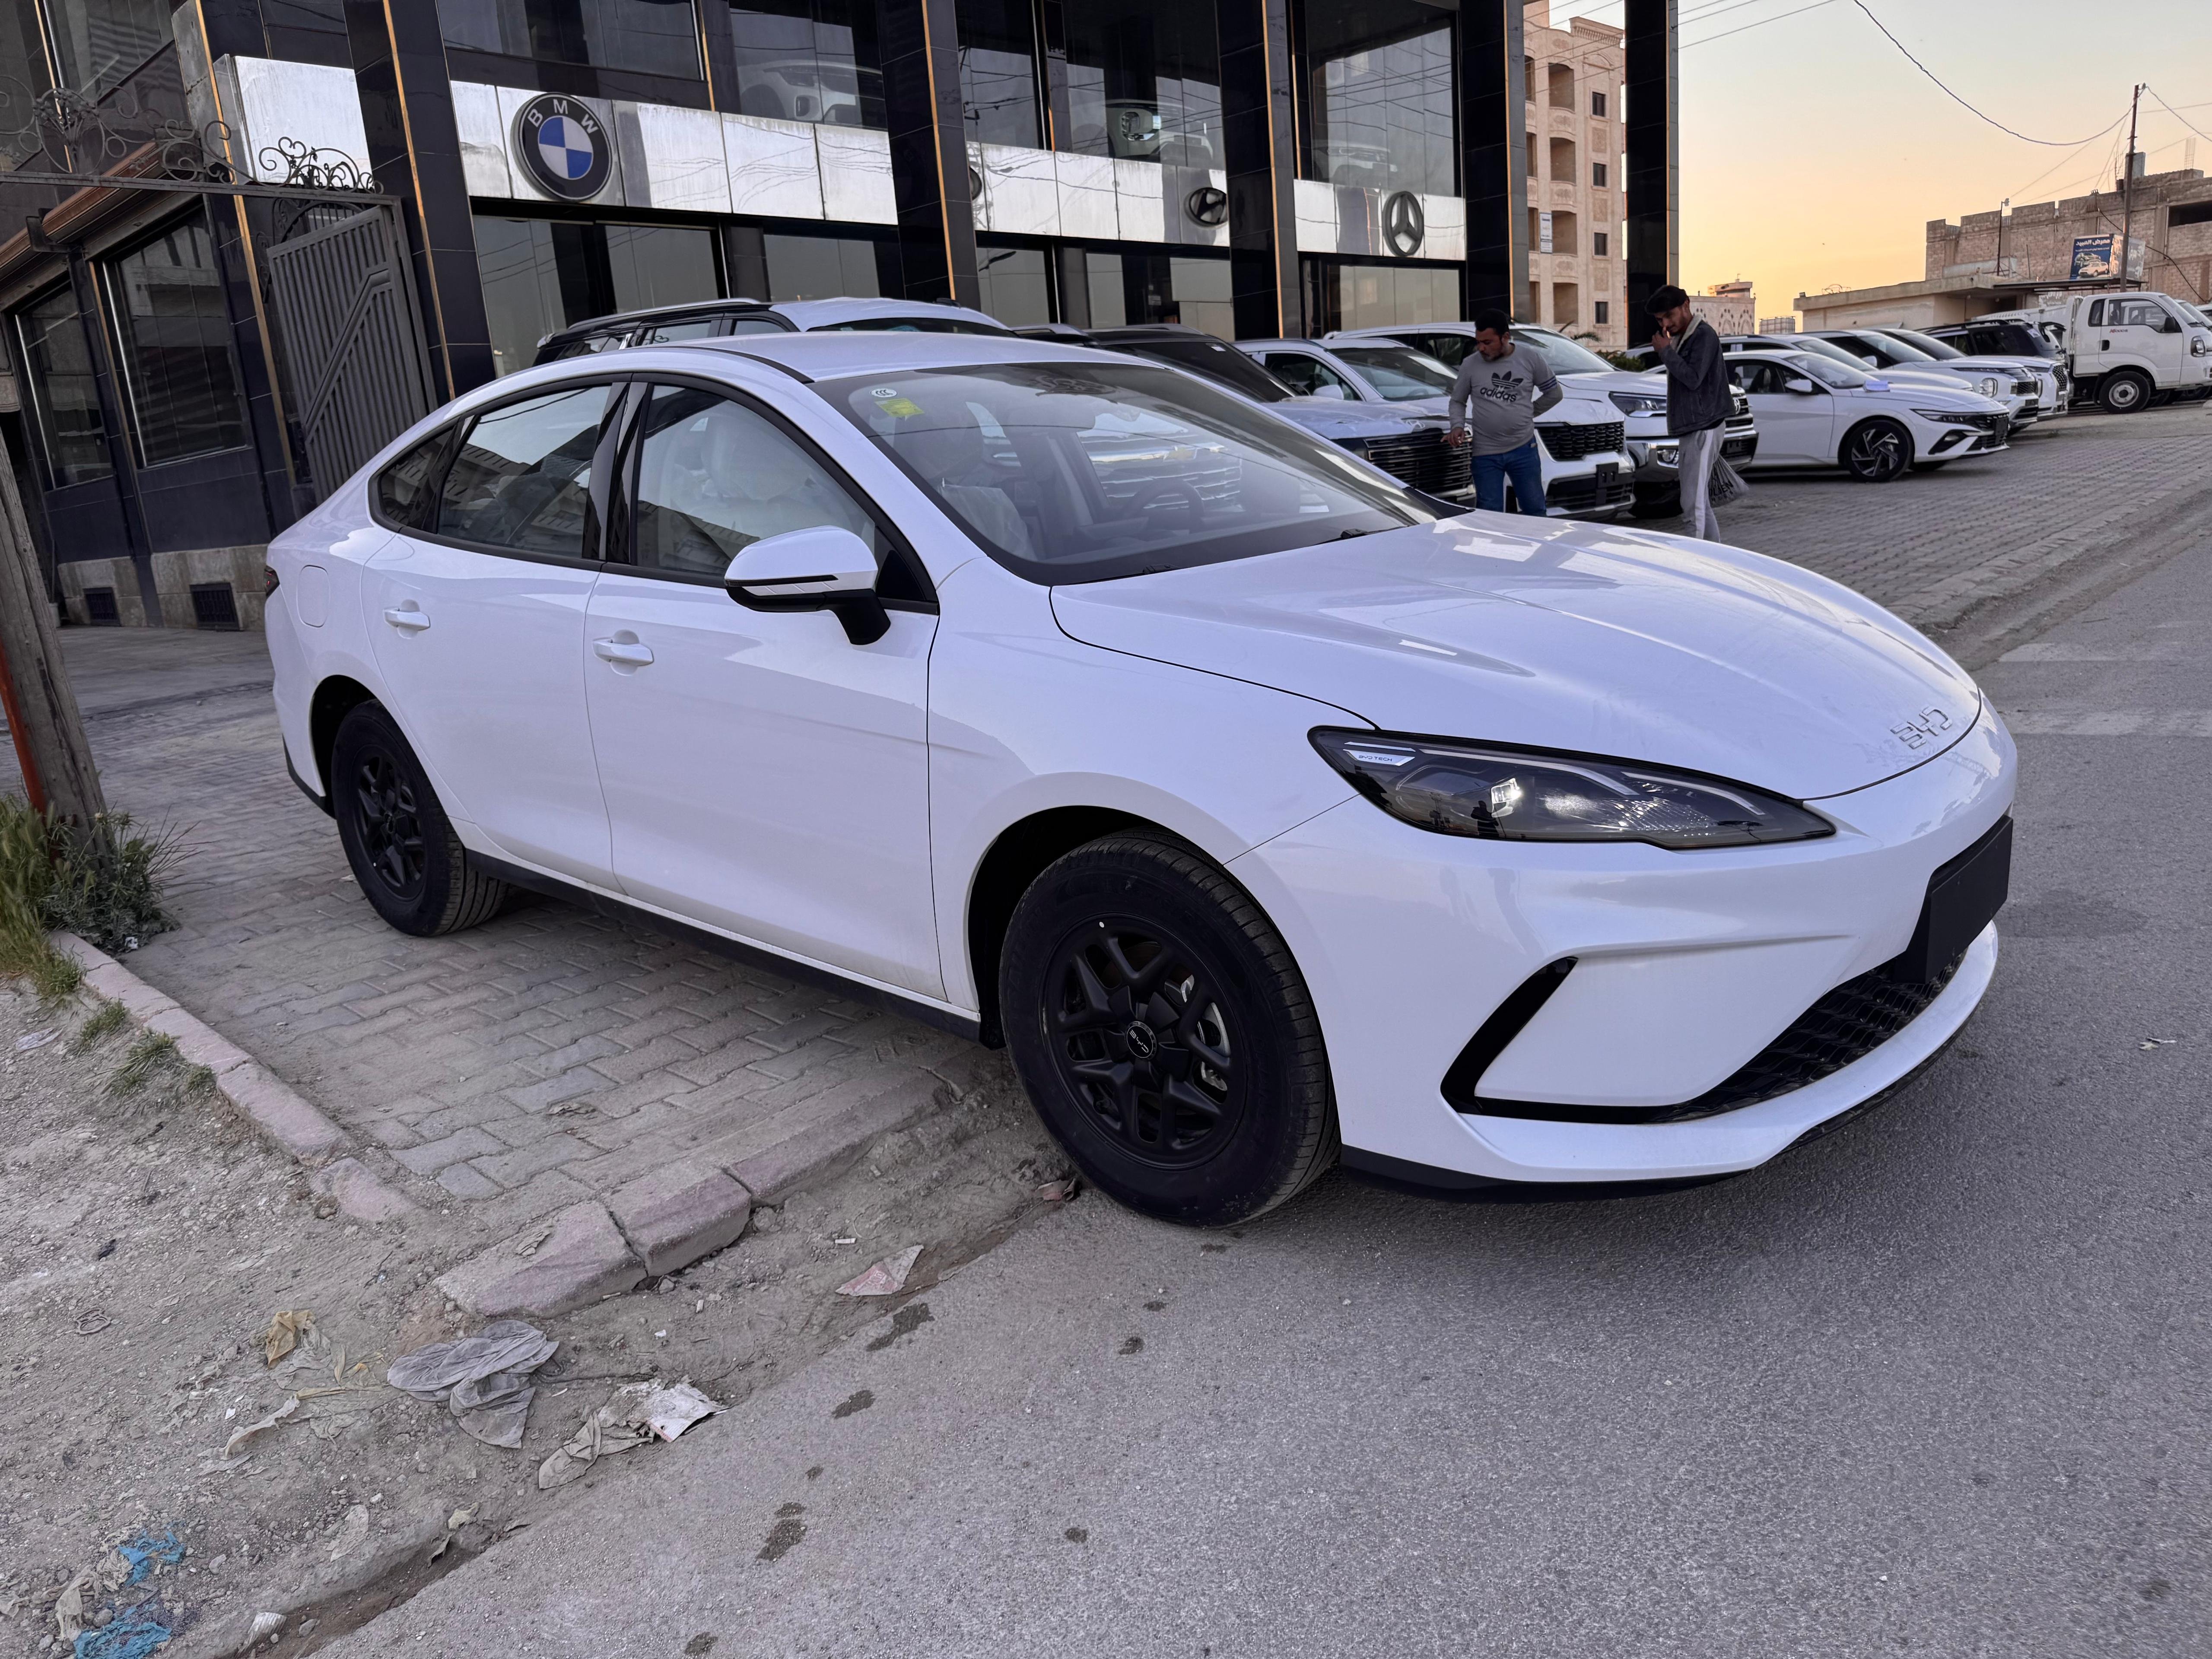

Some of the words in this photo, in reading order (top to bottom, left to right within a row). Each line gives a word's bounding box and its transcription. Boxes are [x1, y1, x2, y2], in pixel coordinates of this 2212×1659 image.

[528, 99, 599, 134] BMW
[1480, 387, 1517, 402] adidas
[1890, 706, 1953, 750] BYD
[1129, 1030, 1149, 1053] BYD
